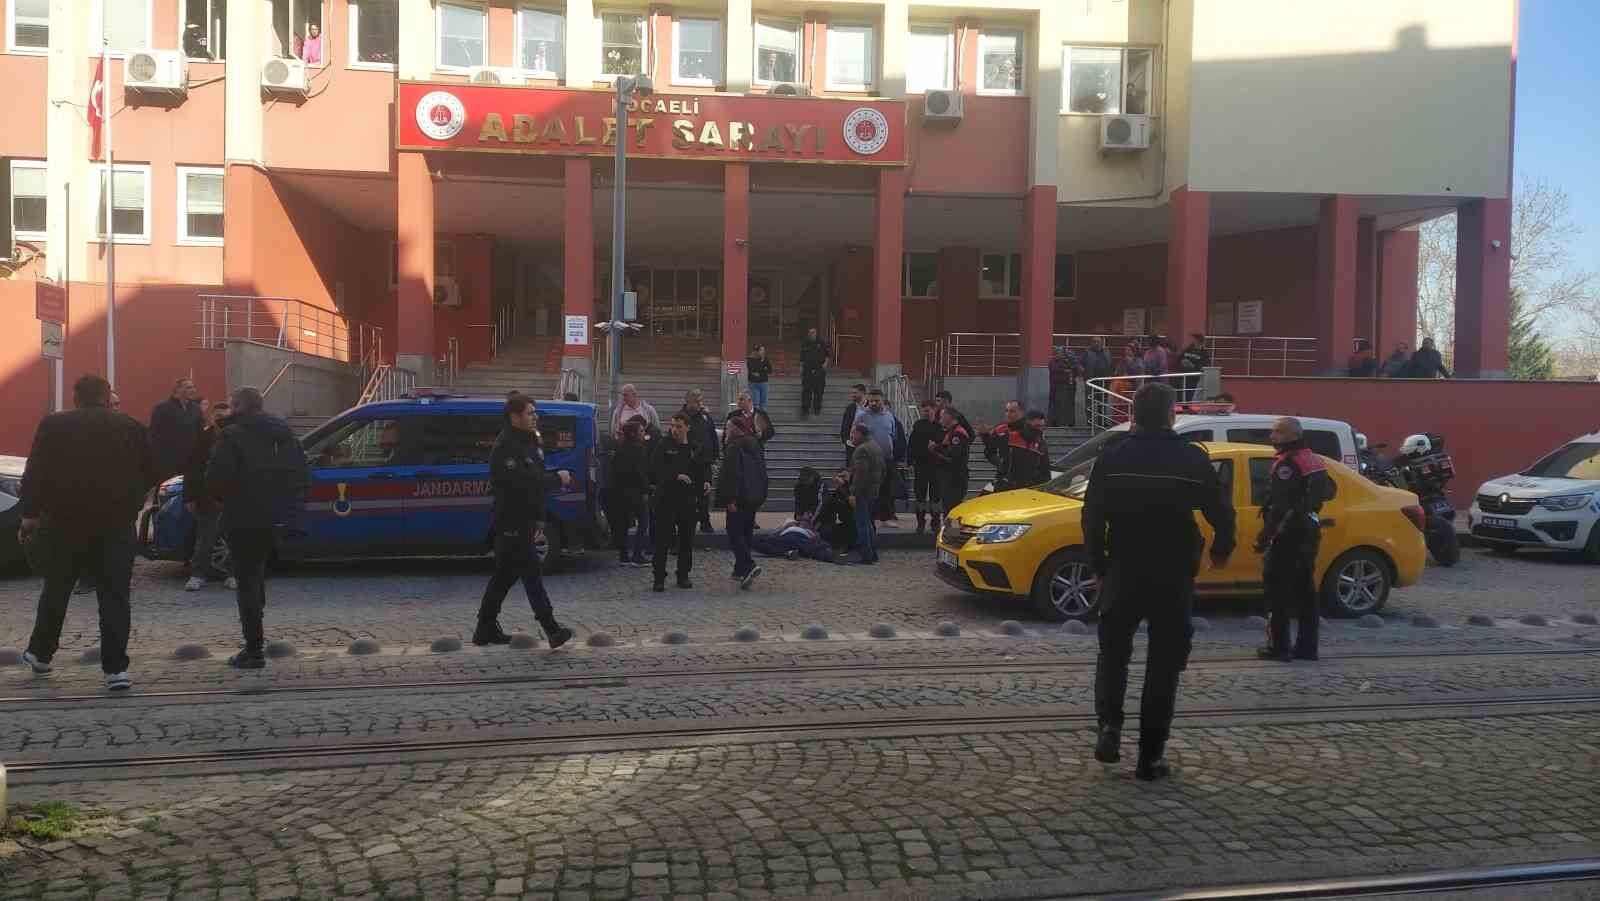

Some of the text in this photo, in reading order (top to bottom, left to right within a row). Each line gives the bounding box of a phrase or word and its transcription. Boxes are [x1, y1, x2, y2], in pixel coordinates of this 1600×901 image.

[611, 97, 700, 115] OCAELİ
[478, 112, 825, 154] ADALET SARAYI
